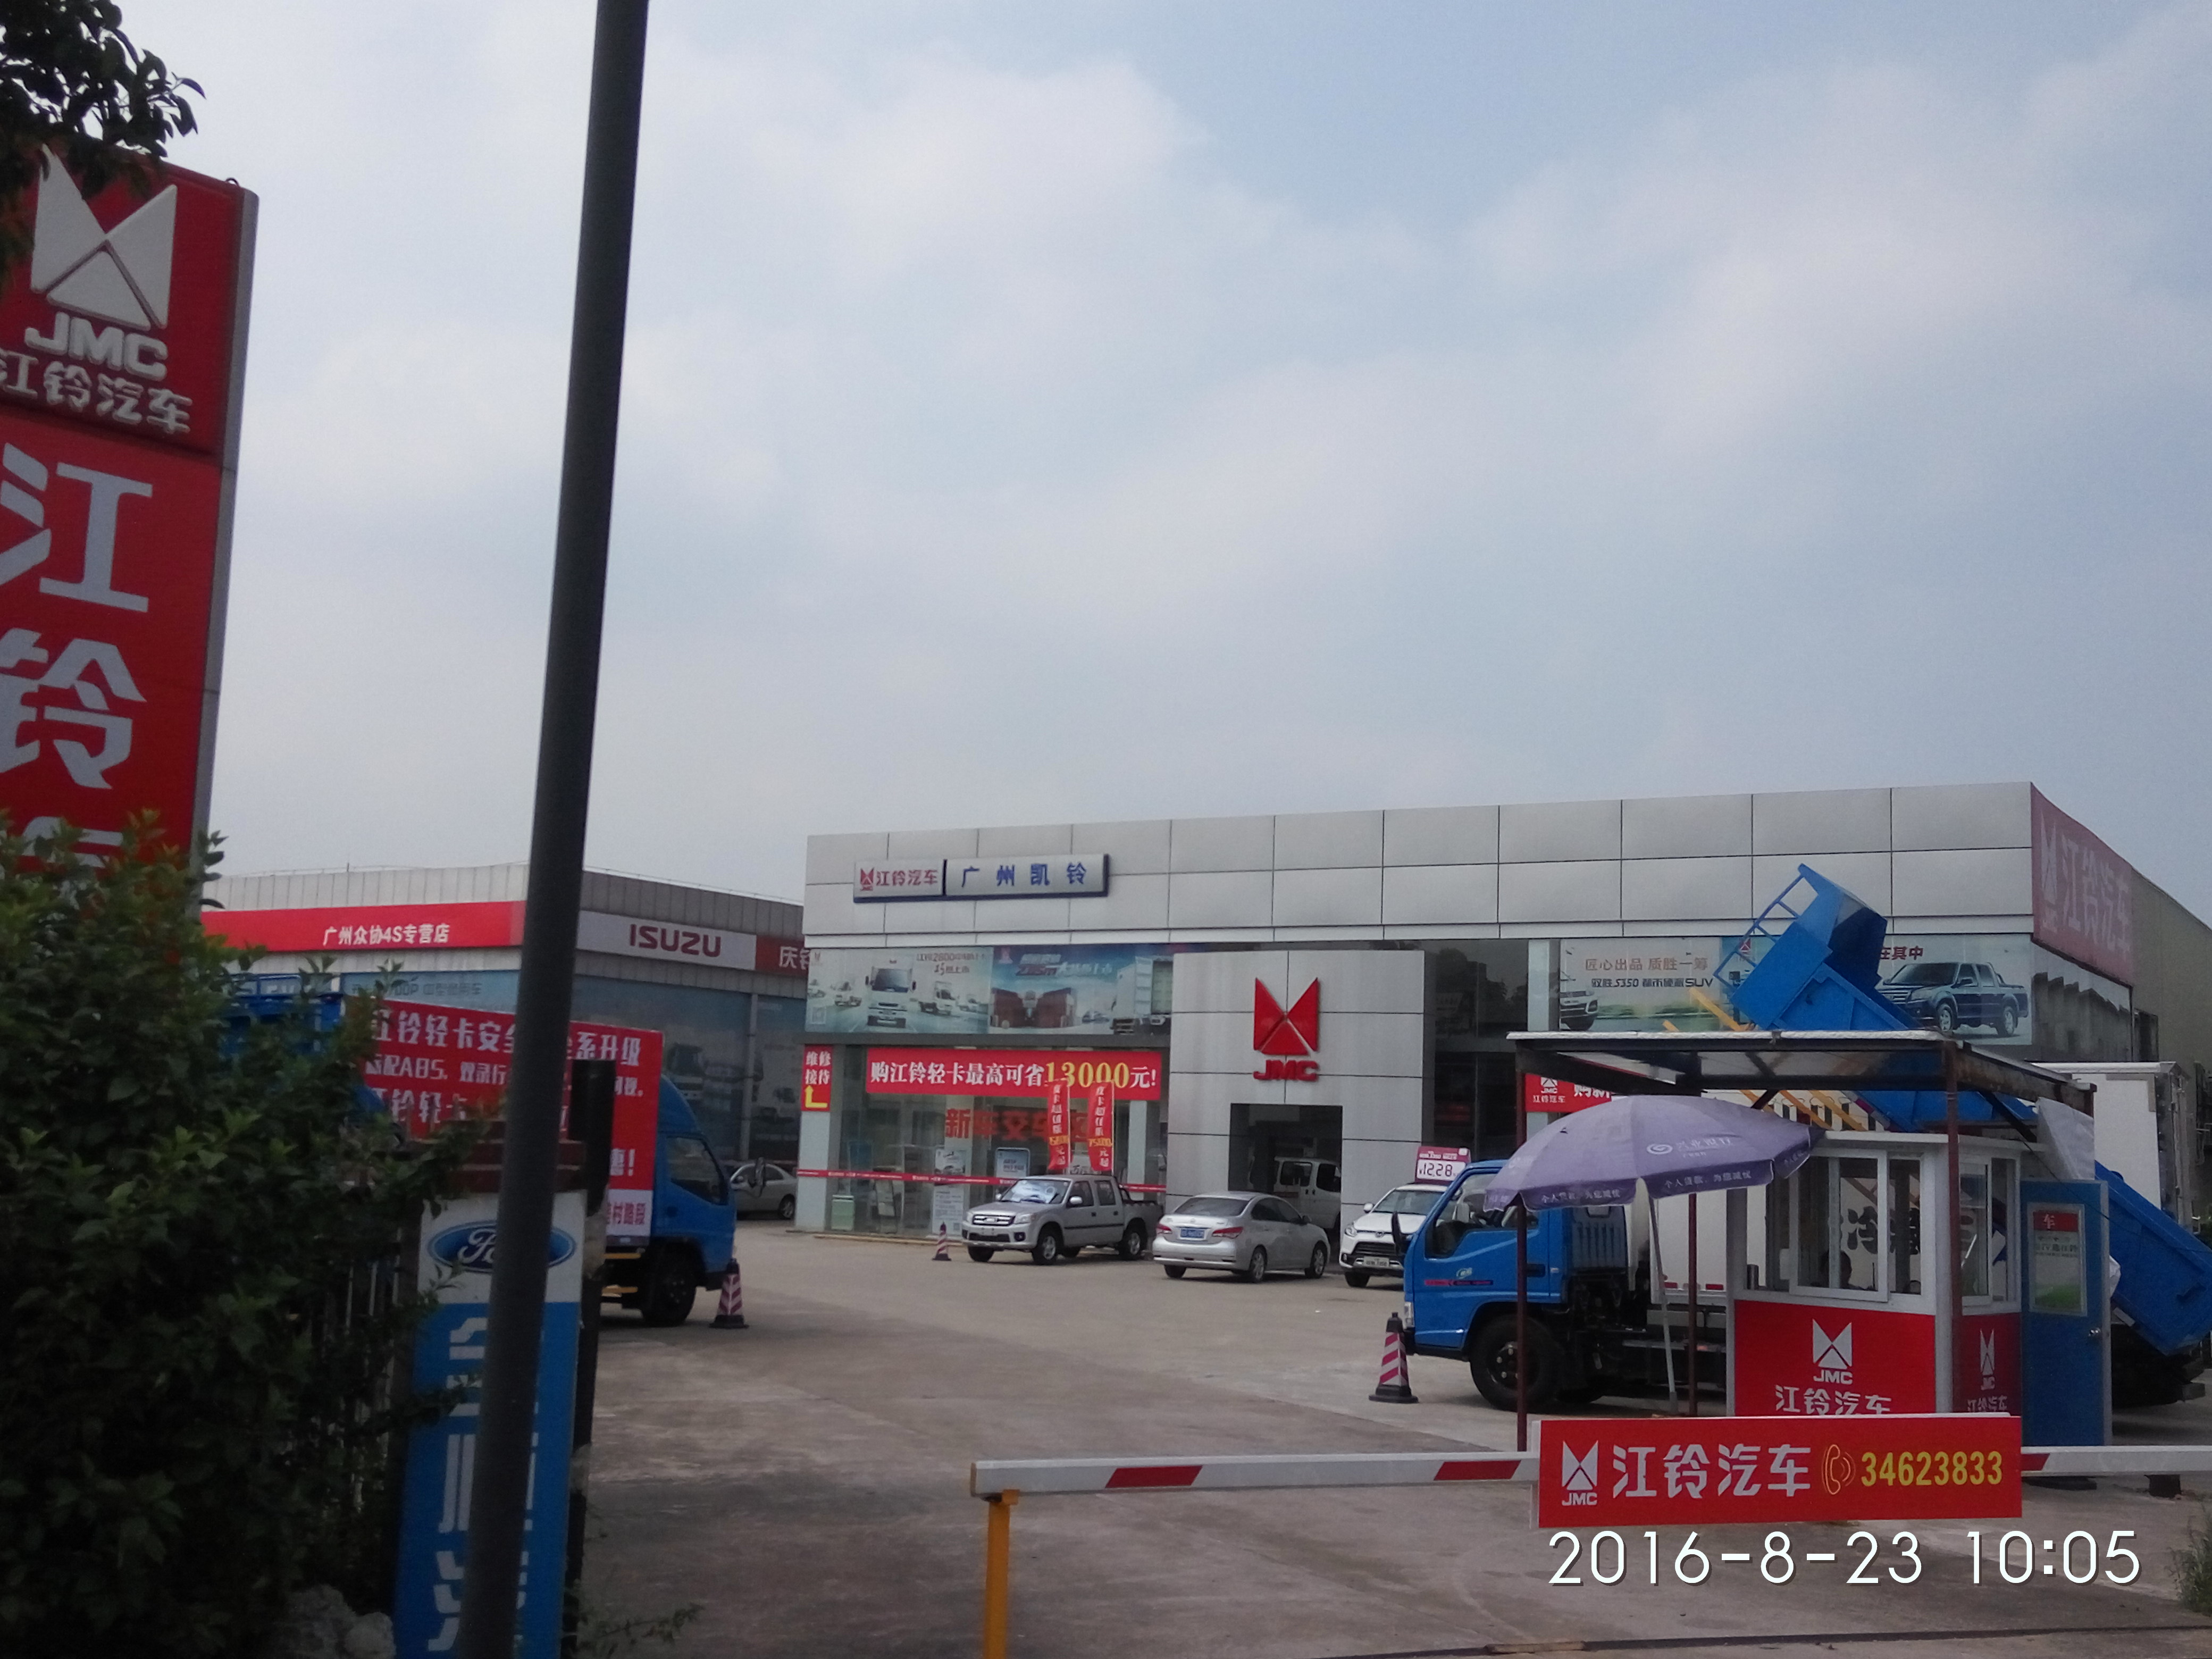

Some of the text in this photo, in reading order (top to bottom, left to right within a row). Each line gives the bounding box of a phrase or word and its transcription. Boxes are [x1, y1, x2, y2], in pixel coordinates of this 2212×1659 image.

[24, 312, 167, 381] JMC
[0, 348, 193, 434] 江铃汽车
[876, 862, 1087, 887] 江铃汽车 广州凯铃
[323, 923, 450, 946] 广州众协4S专营店
[630, 924, 721, 958] ISUZU
[1586, 957, 1708, 971] 匠心出品 质胜一筹
[805, 1051, 831, 1067] 维修
[1253, 1059, 1320, 1082] JMC
[805, 1069, 831, 1085] 接待
[1813, 1369, 1853, 1385] JMC
[1775, 1384, 1892, 1415] 江铃汽车
[1967, 1394, 2008, 1412] 江铃汽车
[1613, 1443, 2003, 1499] 江铃汽车 34623833
[1562, 1492, 1597, 1506] JMC
